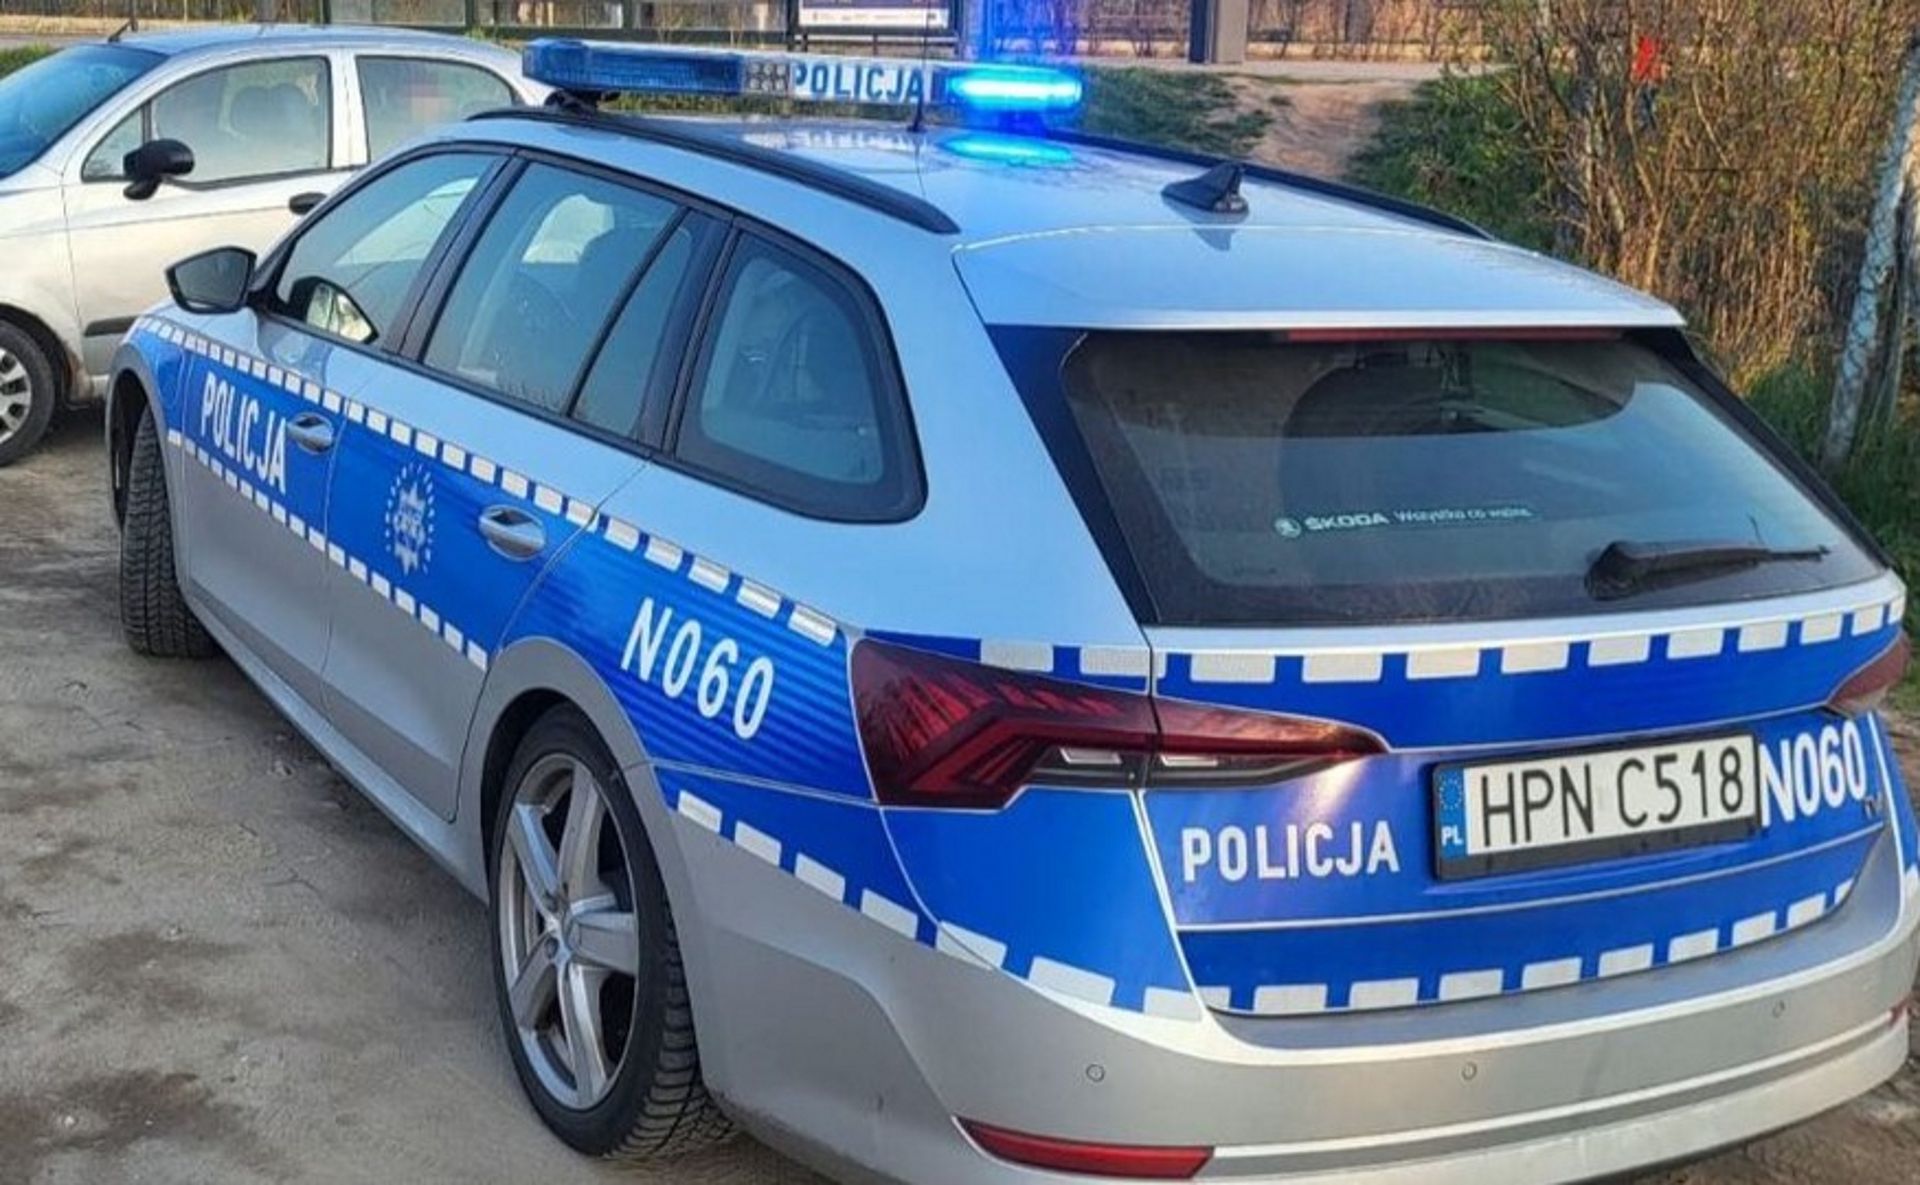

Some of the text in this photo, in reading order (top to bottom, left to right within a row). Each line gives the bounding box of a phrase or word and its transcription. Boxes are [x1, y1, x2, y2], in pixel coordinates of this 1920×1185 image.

[794, 62, 924, 101] POLICJA
[201, 370, 286, 496] POLICJA
[621, 597, 774, 739] N060
[1481, 746, 1743, 847] HPN C518
[1758, 720, 1866, 827] N060
[1182, 820, 1400, 882] POLICJA
[1441, 826, 1464, 846] PL
